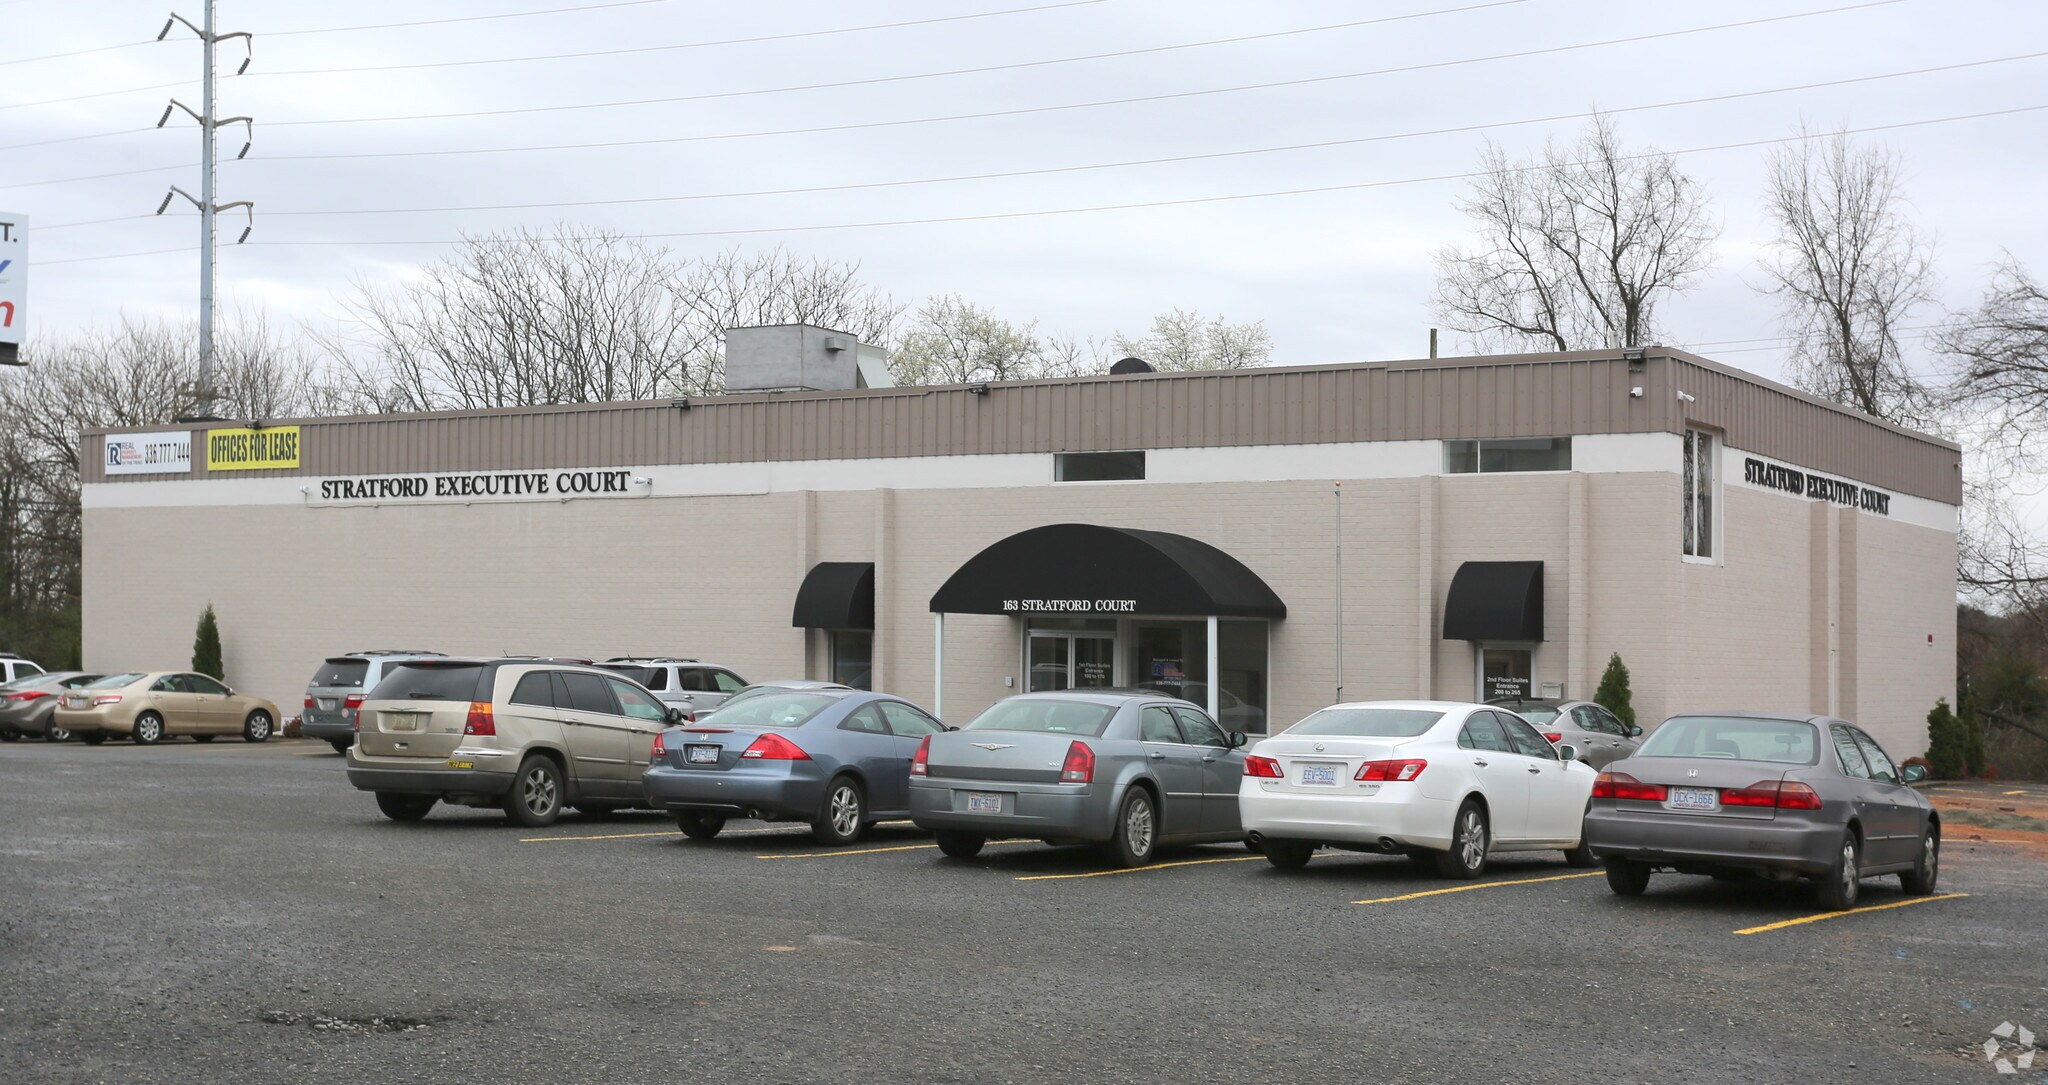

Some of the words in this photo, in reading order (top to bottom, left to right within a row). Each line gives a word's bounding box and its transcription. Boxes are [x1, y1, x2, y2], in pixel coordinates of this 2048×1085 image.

[145, 442, 190, 464] 336.777.7444
[211, 434, 248, 463] OFFICES
[249, 433, 267, 462] FOR
[269, 432, 297, 461] LEASE
[321, 477, 428, 499] STRATFORD
[435, 473, 548, 496] EXECUTIVE
[556, 471, 631, 493] COURT
[1744, 457, 1805, 495] STRATFORD
[1806, 473, 1859, 507] EXECUTIVE
[1860, 487, 1891, 516] COURT
[1002, 600, 1018, 611] 163
[1021, 600, 1091, 611] STRATFORD
[1095, 600, 1136, 611] COURT
[1303, 769, 1335, 781] EEV-5001
